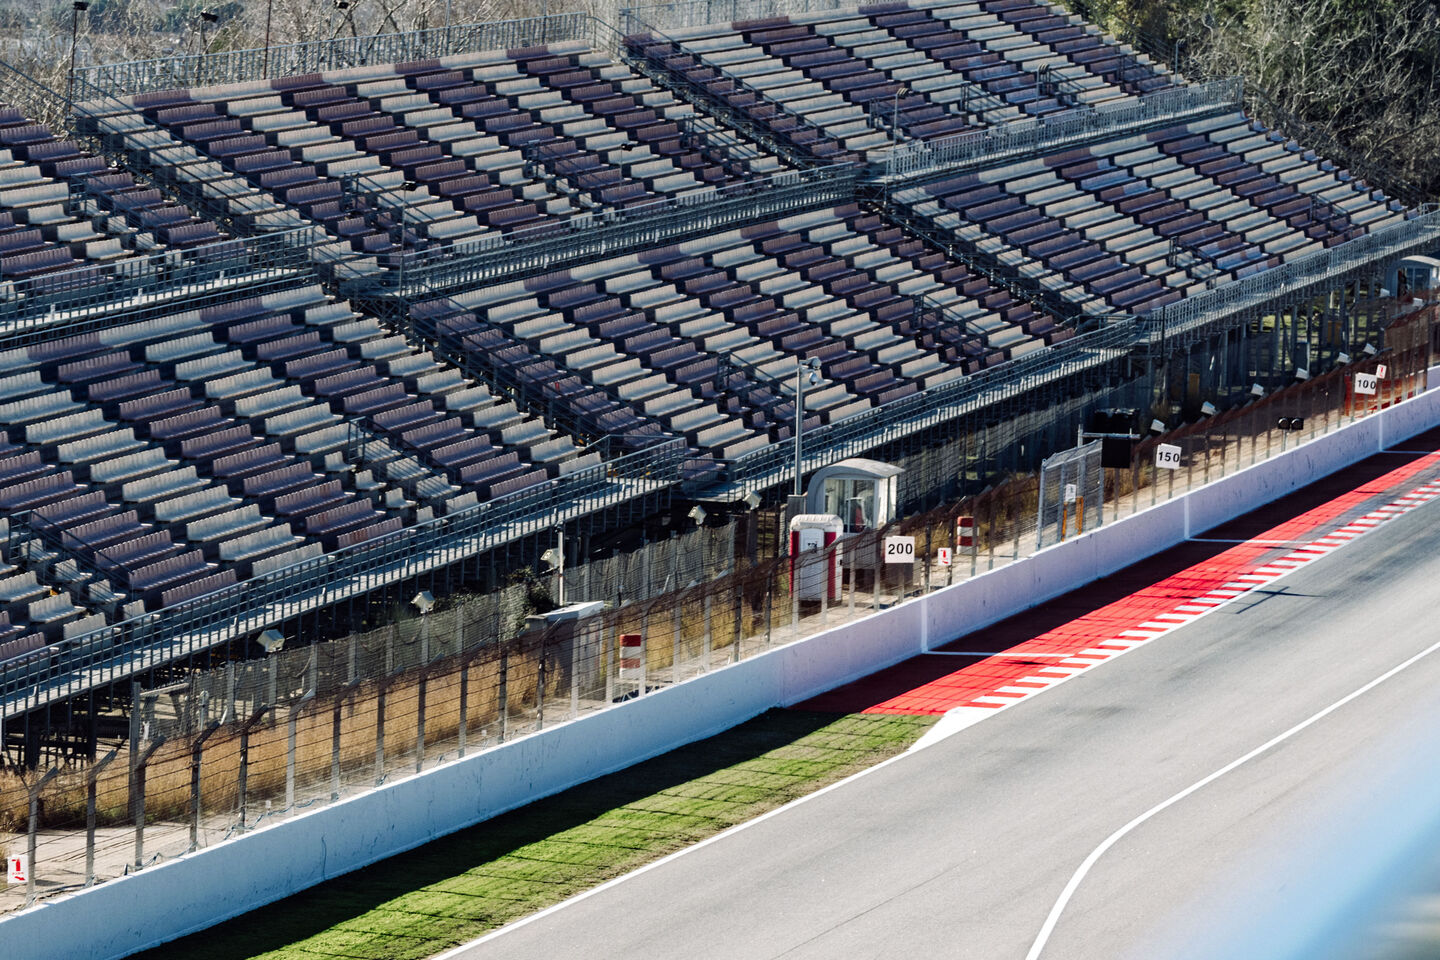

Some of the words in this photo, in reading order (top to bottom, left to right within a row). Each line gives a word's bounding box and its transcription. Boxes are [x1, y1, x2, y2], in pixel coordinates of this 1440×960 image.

[1357, 379, 1376, 389] 100
[1158, 451, 1180, 463] 150
[888, 543, 913, 555] 200
